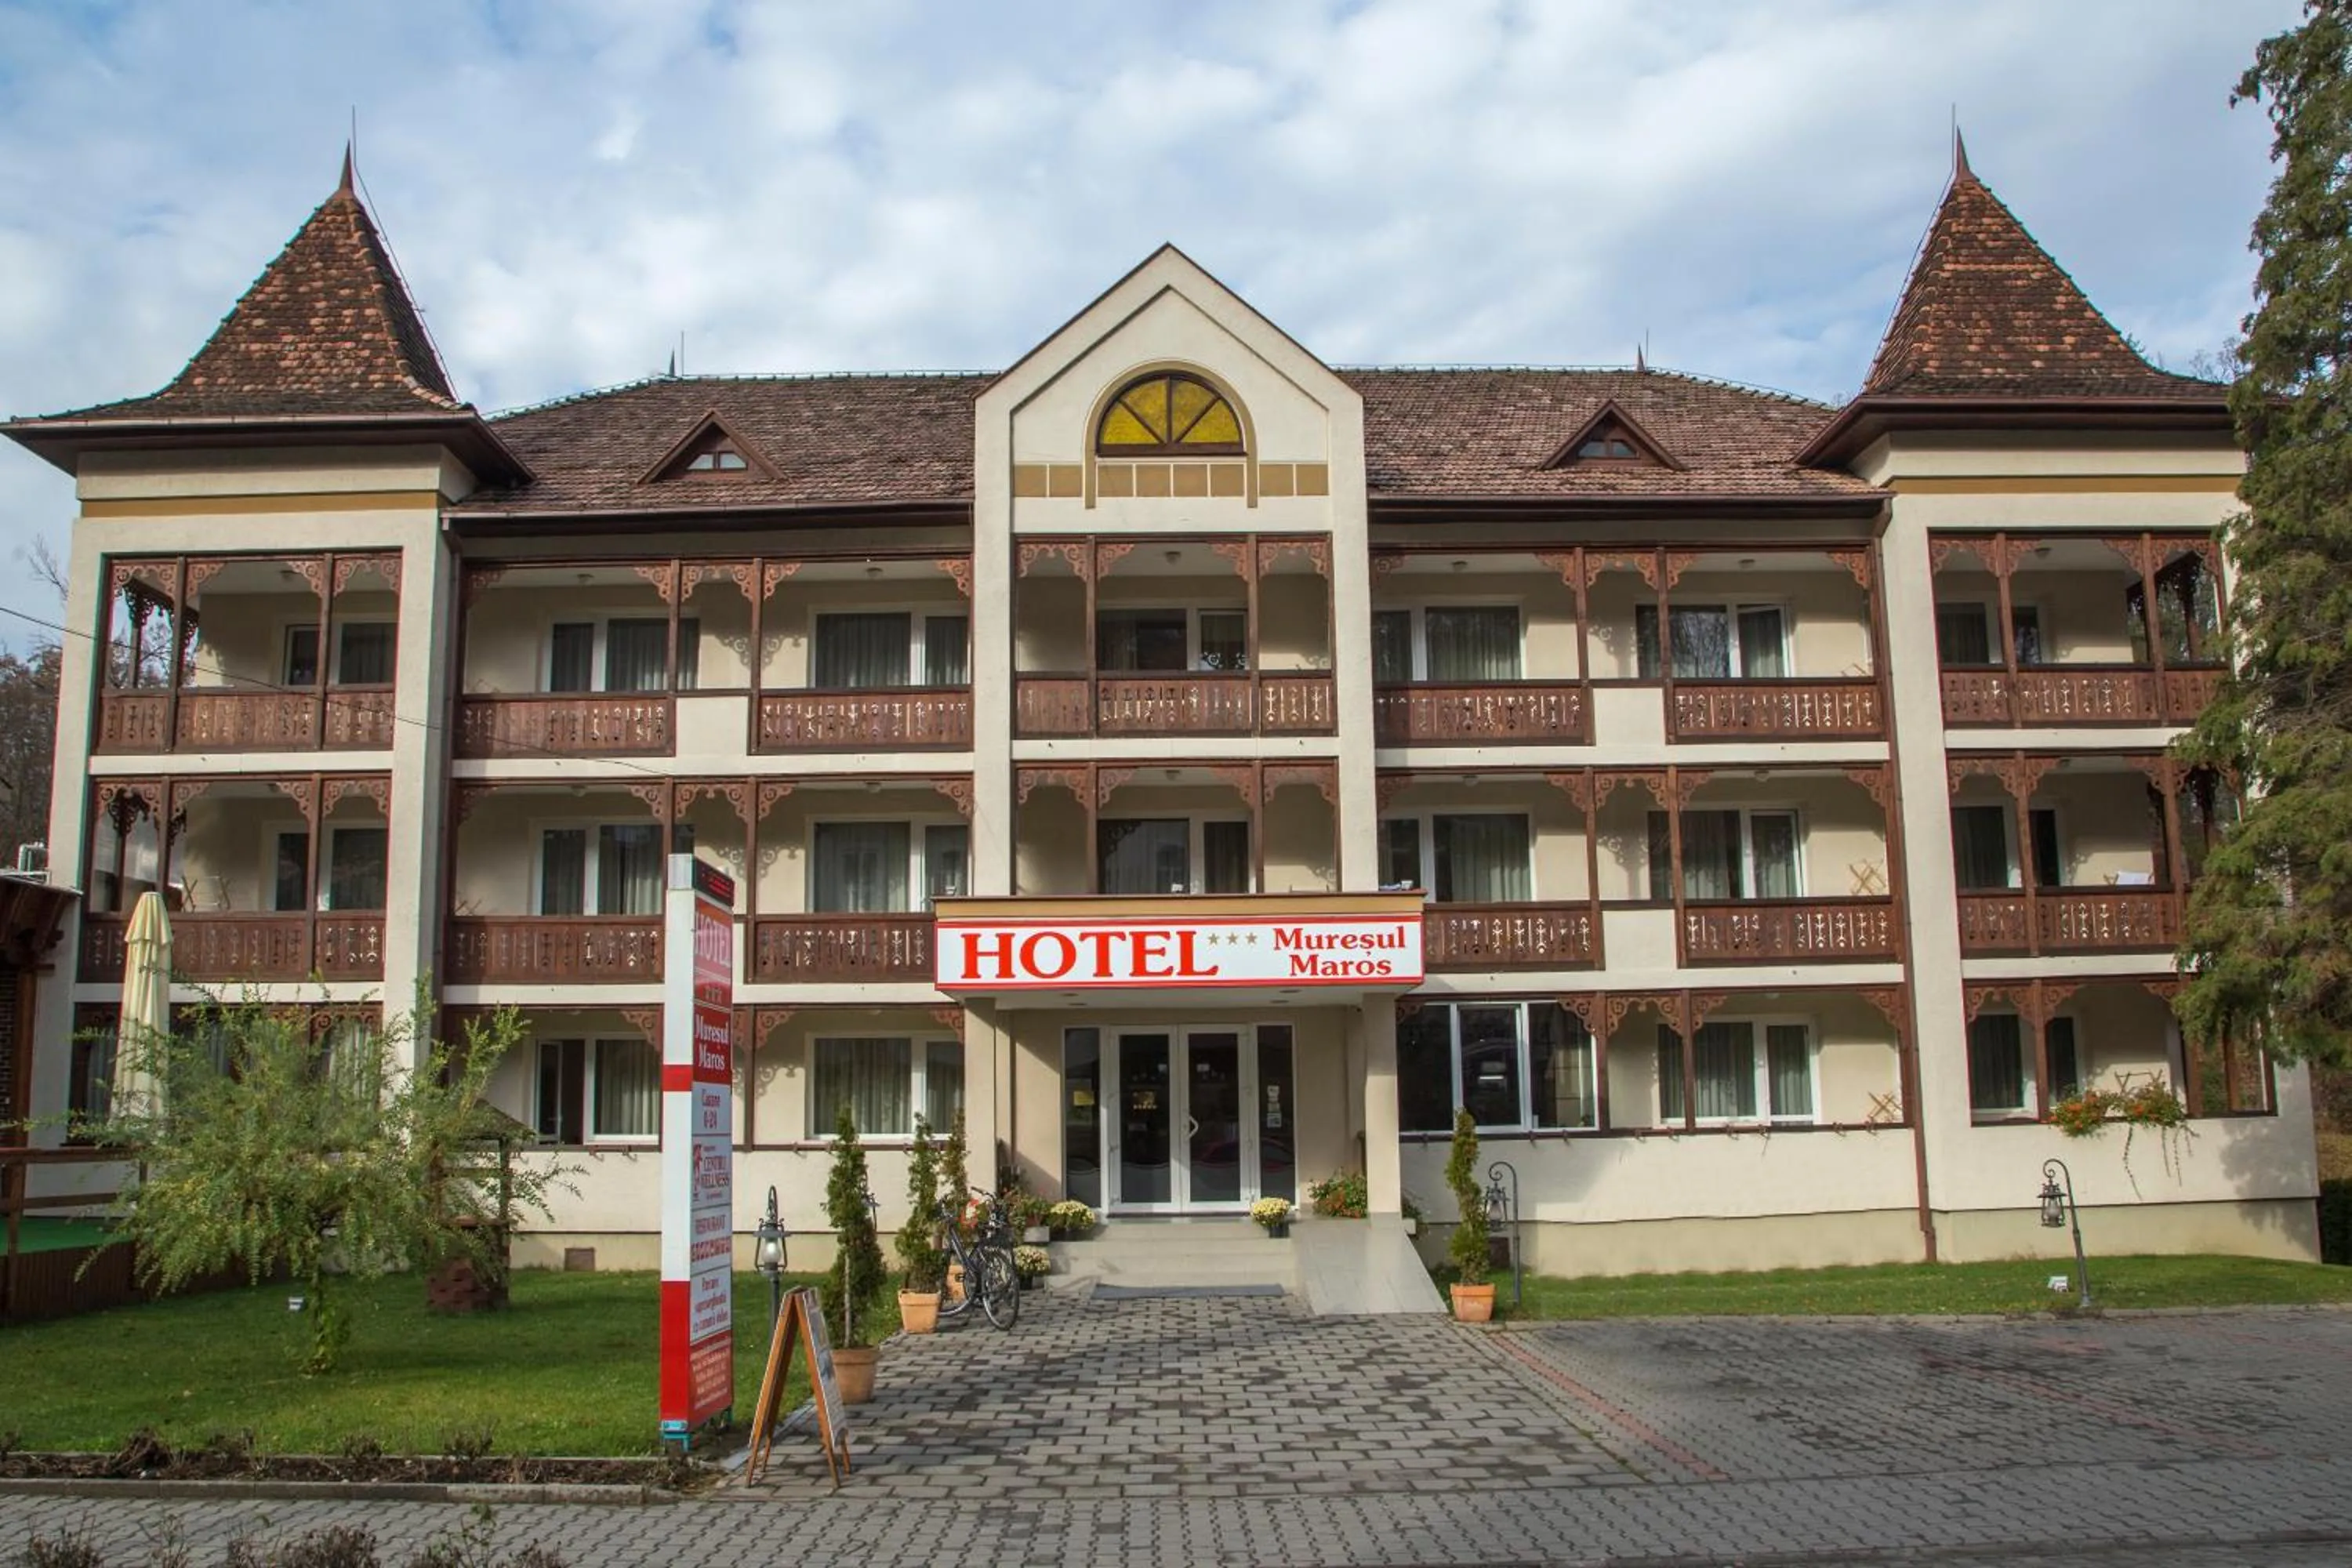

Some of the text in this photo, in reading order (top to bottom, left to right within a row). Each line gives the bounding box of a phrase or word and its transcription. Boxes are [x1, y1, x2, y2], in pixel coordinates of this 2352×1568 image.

[695, 911, 731, 967] HOTEL
[1272, 926, 1406, 956] Mureșul
[960, 931, 1219, 979] HOTEL
[1289, 954, 1392, 977] Maros
[699, 1044, 725, 1070] Maros
